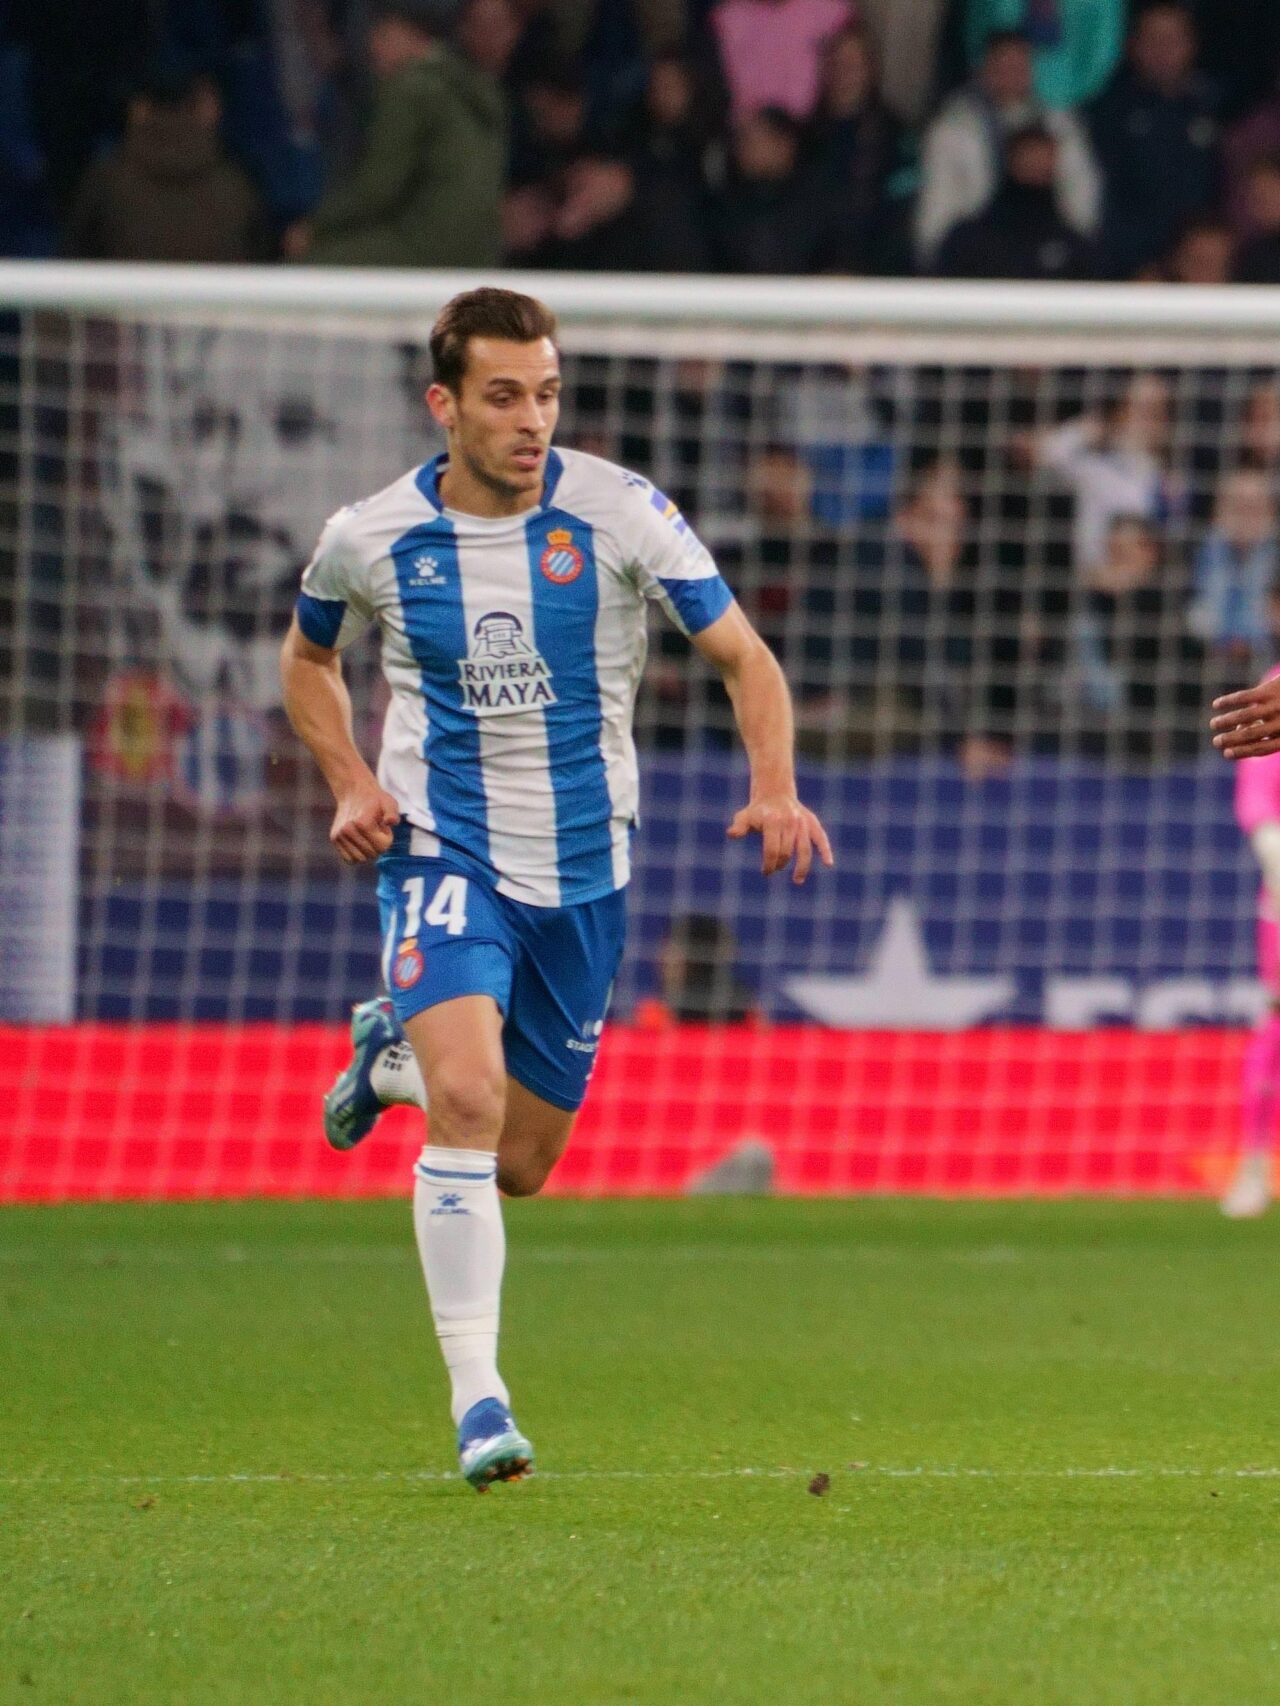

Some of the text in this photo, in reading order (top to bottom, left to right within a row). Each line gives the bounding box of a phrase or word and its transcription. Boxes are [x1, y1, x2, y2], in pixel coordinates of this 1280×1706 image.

[463, 661, 547, 681] RIVIERA
[466, 680, 553, 707] MAYA
[401, 874, 469, 938] 14
